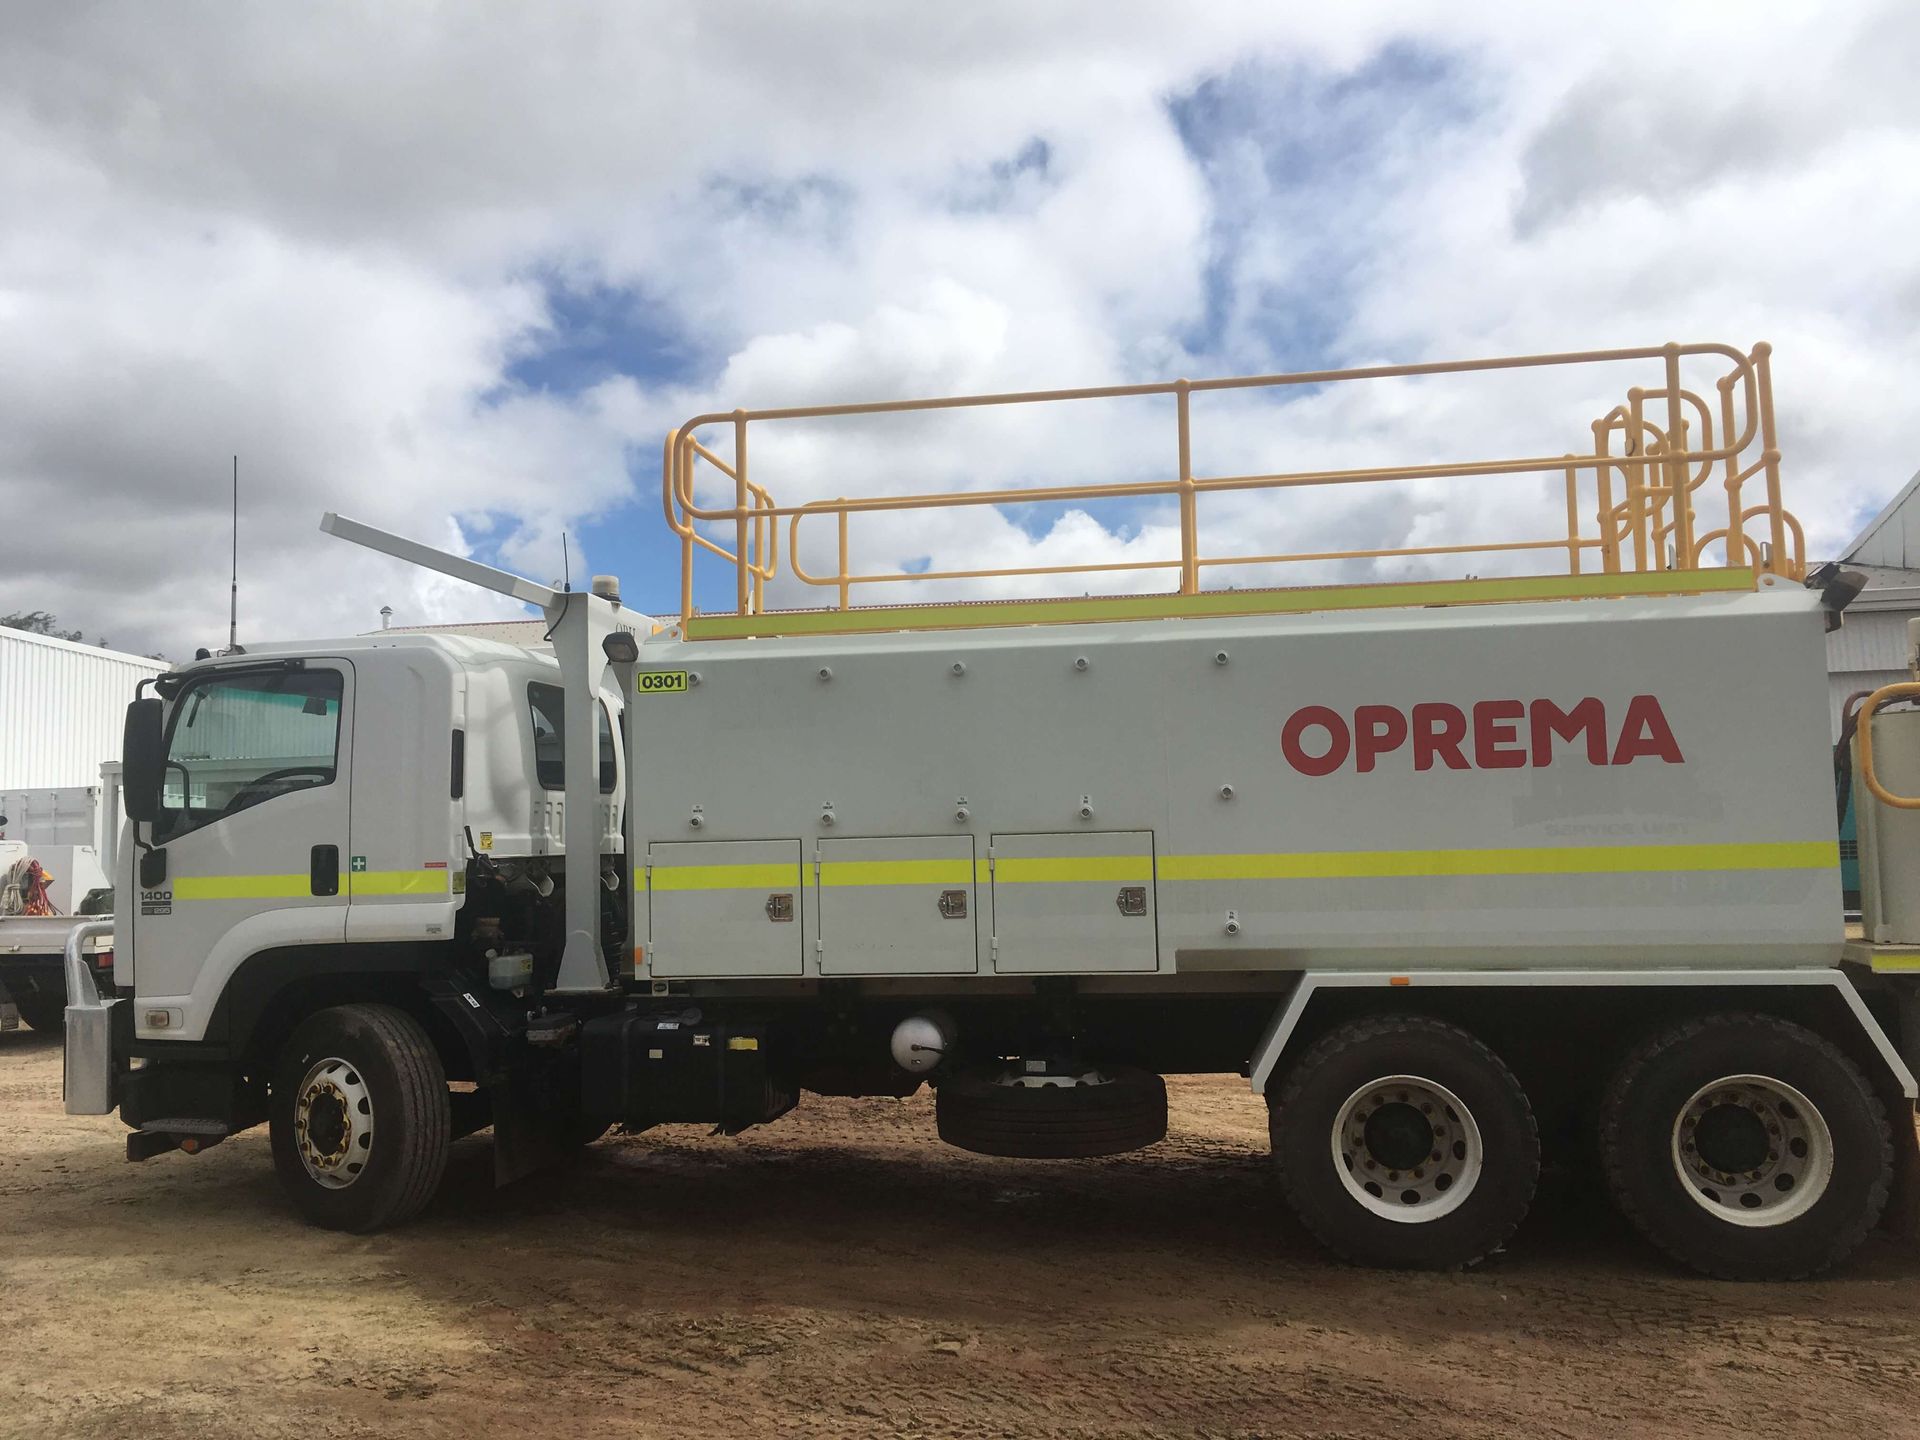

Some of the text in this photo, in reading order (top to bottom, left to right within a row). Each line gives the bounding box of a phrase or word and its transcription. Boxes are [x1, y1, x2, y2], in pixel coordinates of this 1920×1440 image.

[642, 675, 682, 689] 0301
[1281, 695, 1685, 776] OPREMA
[140, 891, 172, 901] 1400
